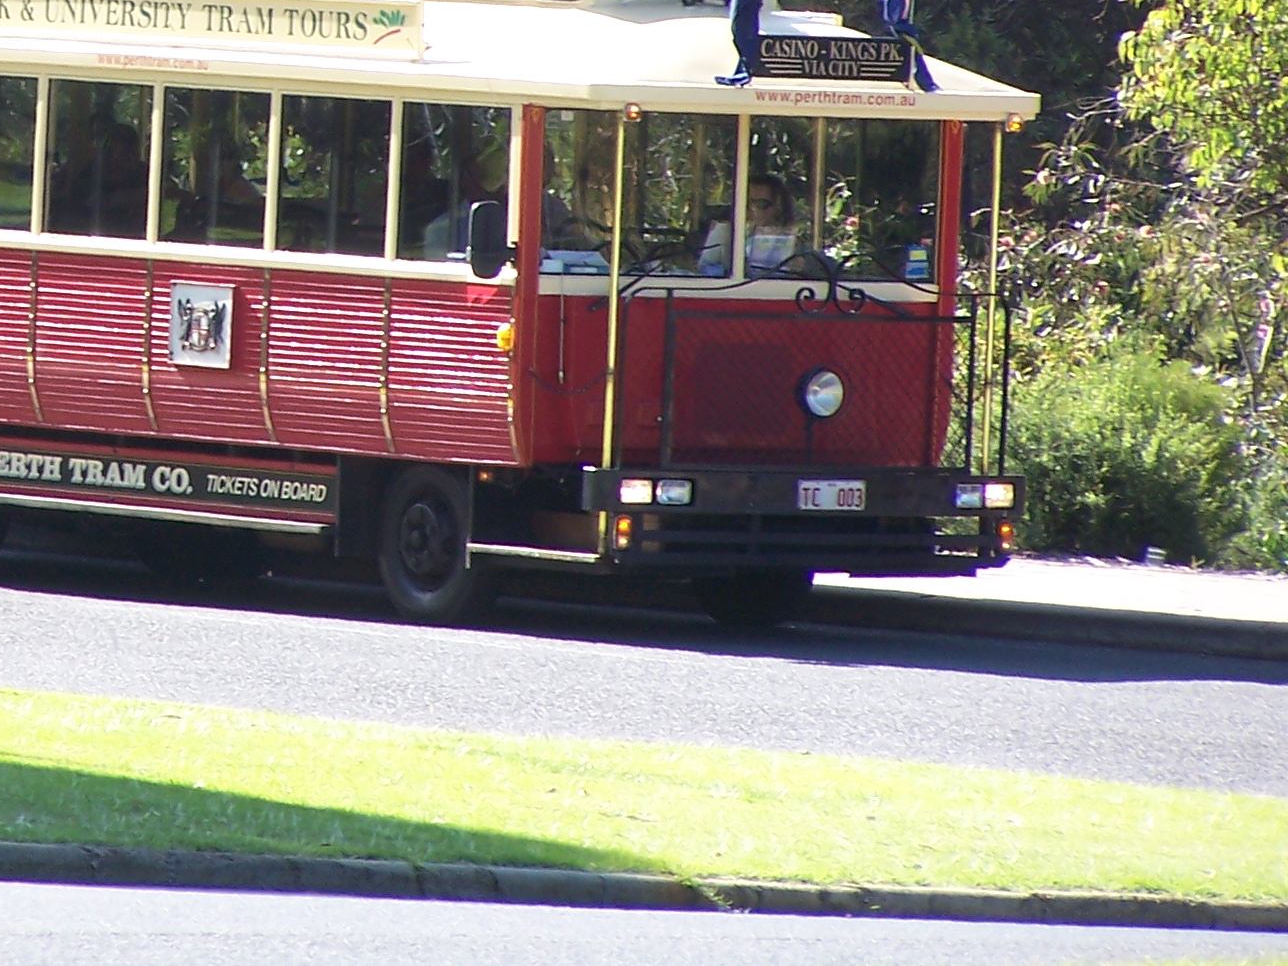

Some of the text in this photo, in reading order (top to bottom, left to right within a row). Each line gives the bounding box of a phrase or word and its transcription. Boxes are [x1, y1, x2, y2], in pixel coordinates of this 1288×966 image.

[202, 4, 274, 35] TRAM
[283, 8, 368, 41] TOURS
[761, 38, 819, 59] CASINO
[829, 40, 877, 60] KINGS
[879, 43, 904, 62] PK.
[803, 60, 862, 77] VIA CITY
[755, 91, 916, 106] www.perthtram.com.au
[68, 457, 146, 489] TRAM
[151, 465, 192, 495] CO.
[206, 474, 258, 497] TICKETS
[260, 480, 281, 498] ON
[282, 482, 327, 503] BOARD
[802, 487, 862, 508] TC 003
